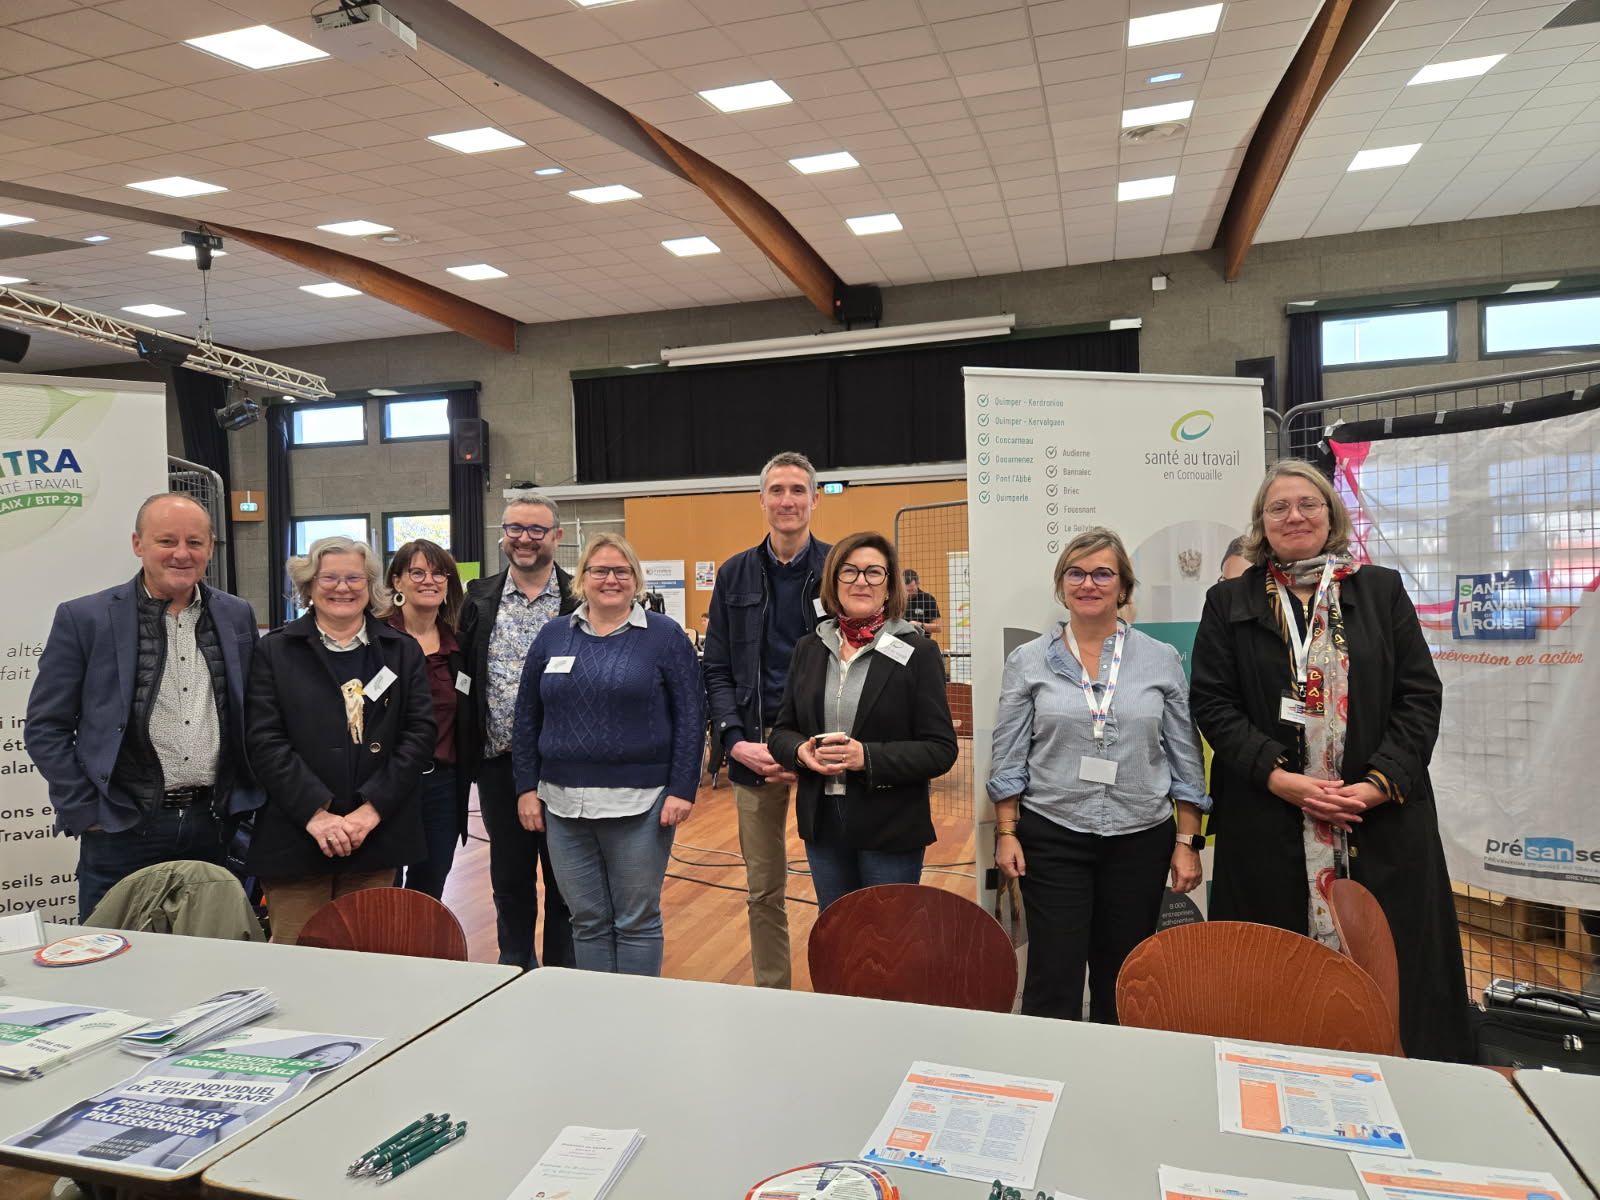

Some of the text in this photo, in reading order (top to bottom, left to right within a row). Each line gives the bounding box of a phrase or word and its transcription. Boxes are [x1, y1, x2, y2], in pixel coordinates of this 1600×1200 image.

[995, 396, 1021, 407] Quimper
[995, 416, 1022, 427] Quimper
[995, 435, 1034, 445] Concarneau
[1062, 449, 1090, 457] Audierne
[1144, 449, 1240, 466] santé au travail
[995, 455, 1034, 464] Douarnenez
[1063, 467, 1092, 476] Bannalec
[1163, 469, 1223, 481] en Cornouaille
[25, 478, 84, 491] TRAVAIL
[995, 474, 1011, 483] Pont
[1063, 486, 1080, 495] Briec
[0, 498, 24, 512] AIX
[35, 495, 60, 505] BTP
[63, 495, 79, 505] 29
[1063, 505, 1097, 514] Fouesnant
[1459, 578, 1516, 597] SANTÉ
[1459, 600, 1533, 614] TRAVAIL
[1515, 653, 1535, 666] en
[1538, 650, 1584, 665] action
[2, 874, 43, 890] seils
[175, 1058, 299, 1076] PROFESSIONNELS
[126, 1083, 148, 1092] DE
[197, 1090, 219, 1098] DE
[148, 1079, 276, 1096] SUIVI INDIVIDUEL
[92, 1103, 115, 1113] LA
[206, 1111, 229, 1121] DE
[82, 1110, 203, 1137] PROFESSIONNEL
